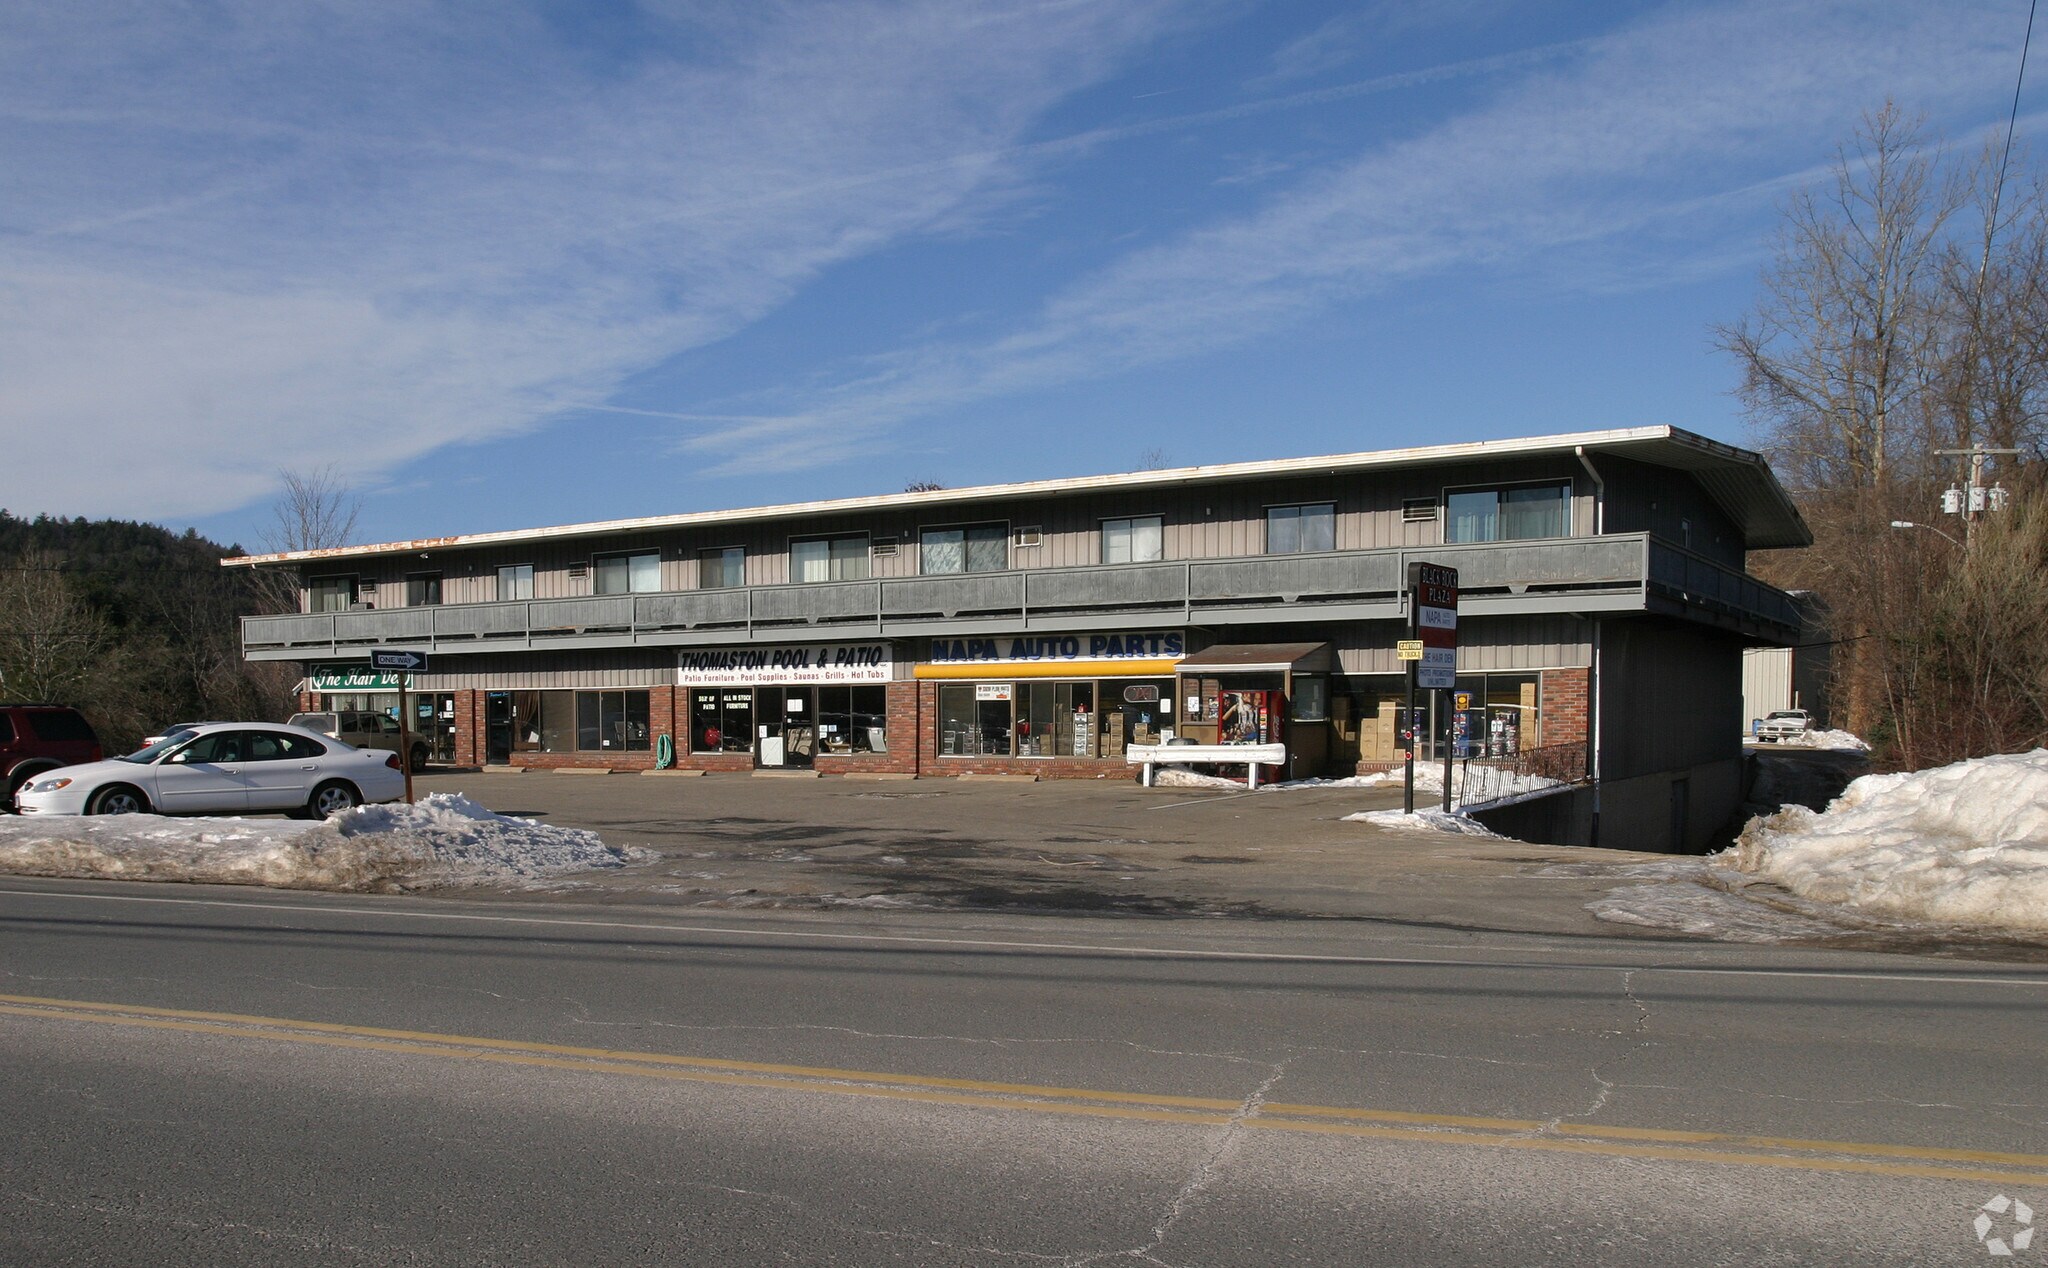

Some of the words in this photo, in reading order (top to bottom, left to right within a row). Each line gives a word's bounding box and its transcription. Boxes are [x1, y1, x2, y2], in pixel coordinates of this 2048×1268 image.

[1422, 566, 1440, 585] BLACK
[1429, 588, 1450, 604] PLAZA
[1425, 610, 1441, 624] NAPA
[932, 639, 1000, 662] NAPA
[1009, 636, 1080, 660] AUTO
[1089, 632, 1183, 658] PARTS
[1400, 642, 1420, 650] CAUTION
[380, 656, 396, 664] ONE
[681, 650, 767, 671] THOMASTON
[771, 648, 810, 670] POOL
[816, 648, 828, 668] &
[835, 646, 884, 668] PATIO
[1432, 653, 1443, 663] HAIR
[1444, 654, 1454, 664] DEN
[317, 668, 340, 686] The
[344, 668, 376, 686] Hair
[684, 674, 702, 682] Patio
[704, 674, 734, 682] Furniture
[740, 673, 755, 682] Pool
[758, 672, 788, 682] Supplies
[794, 672, 820, 680] Saunas
[825, 671, 845, 680] Grills
[852, 670, 864, 679] Hot
[868, 670, 884, 678] Tubs
